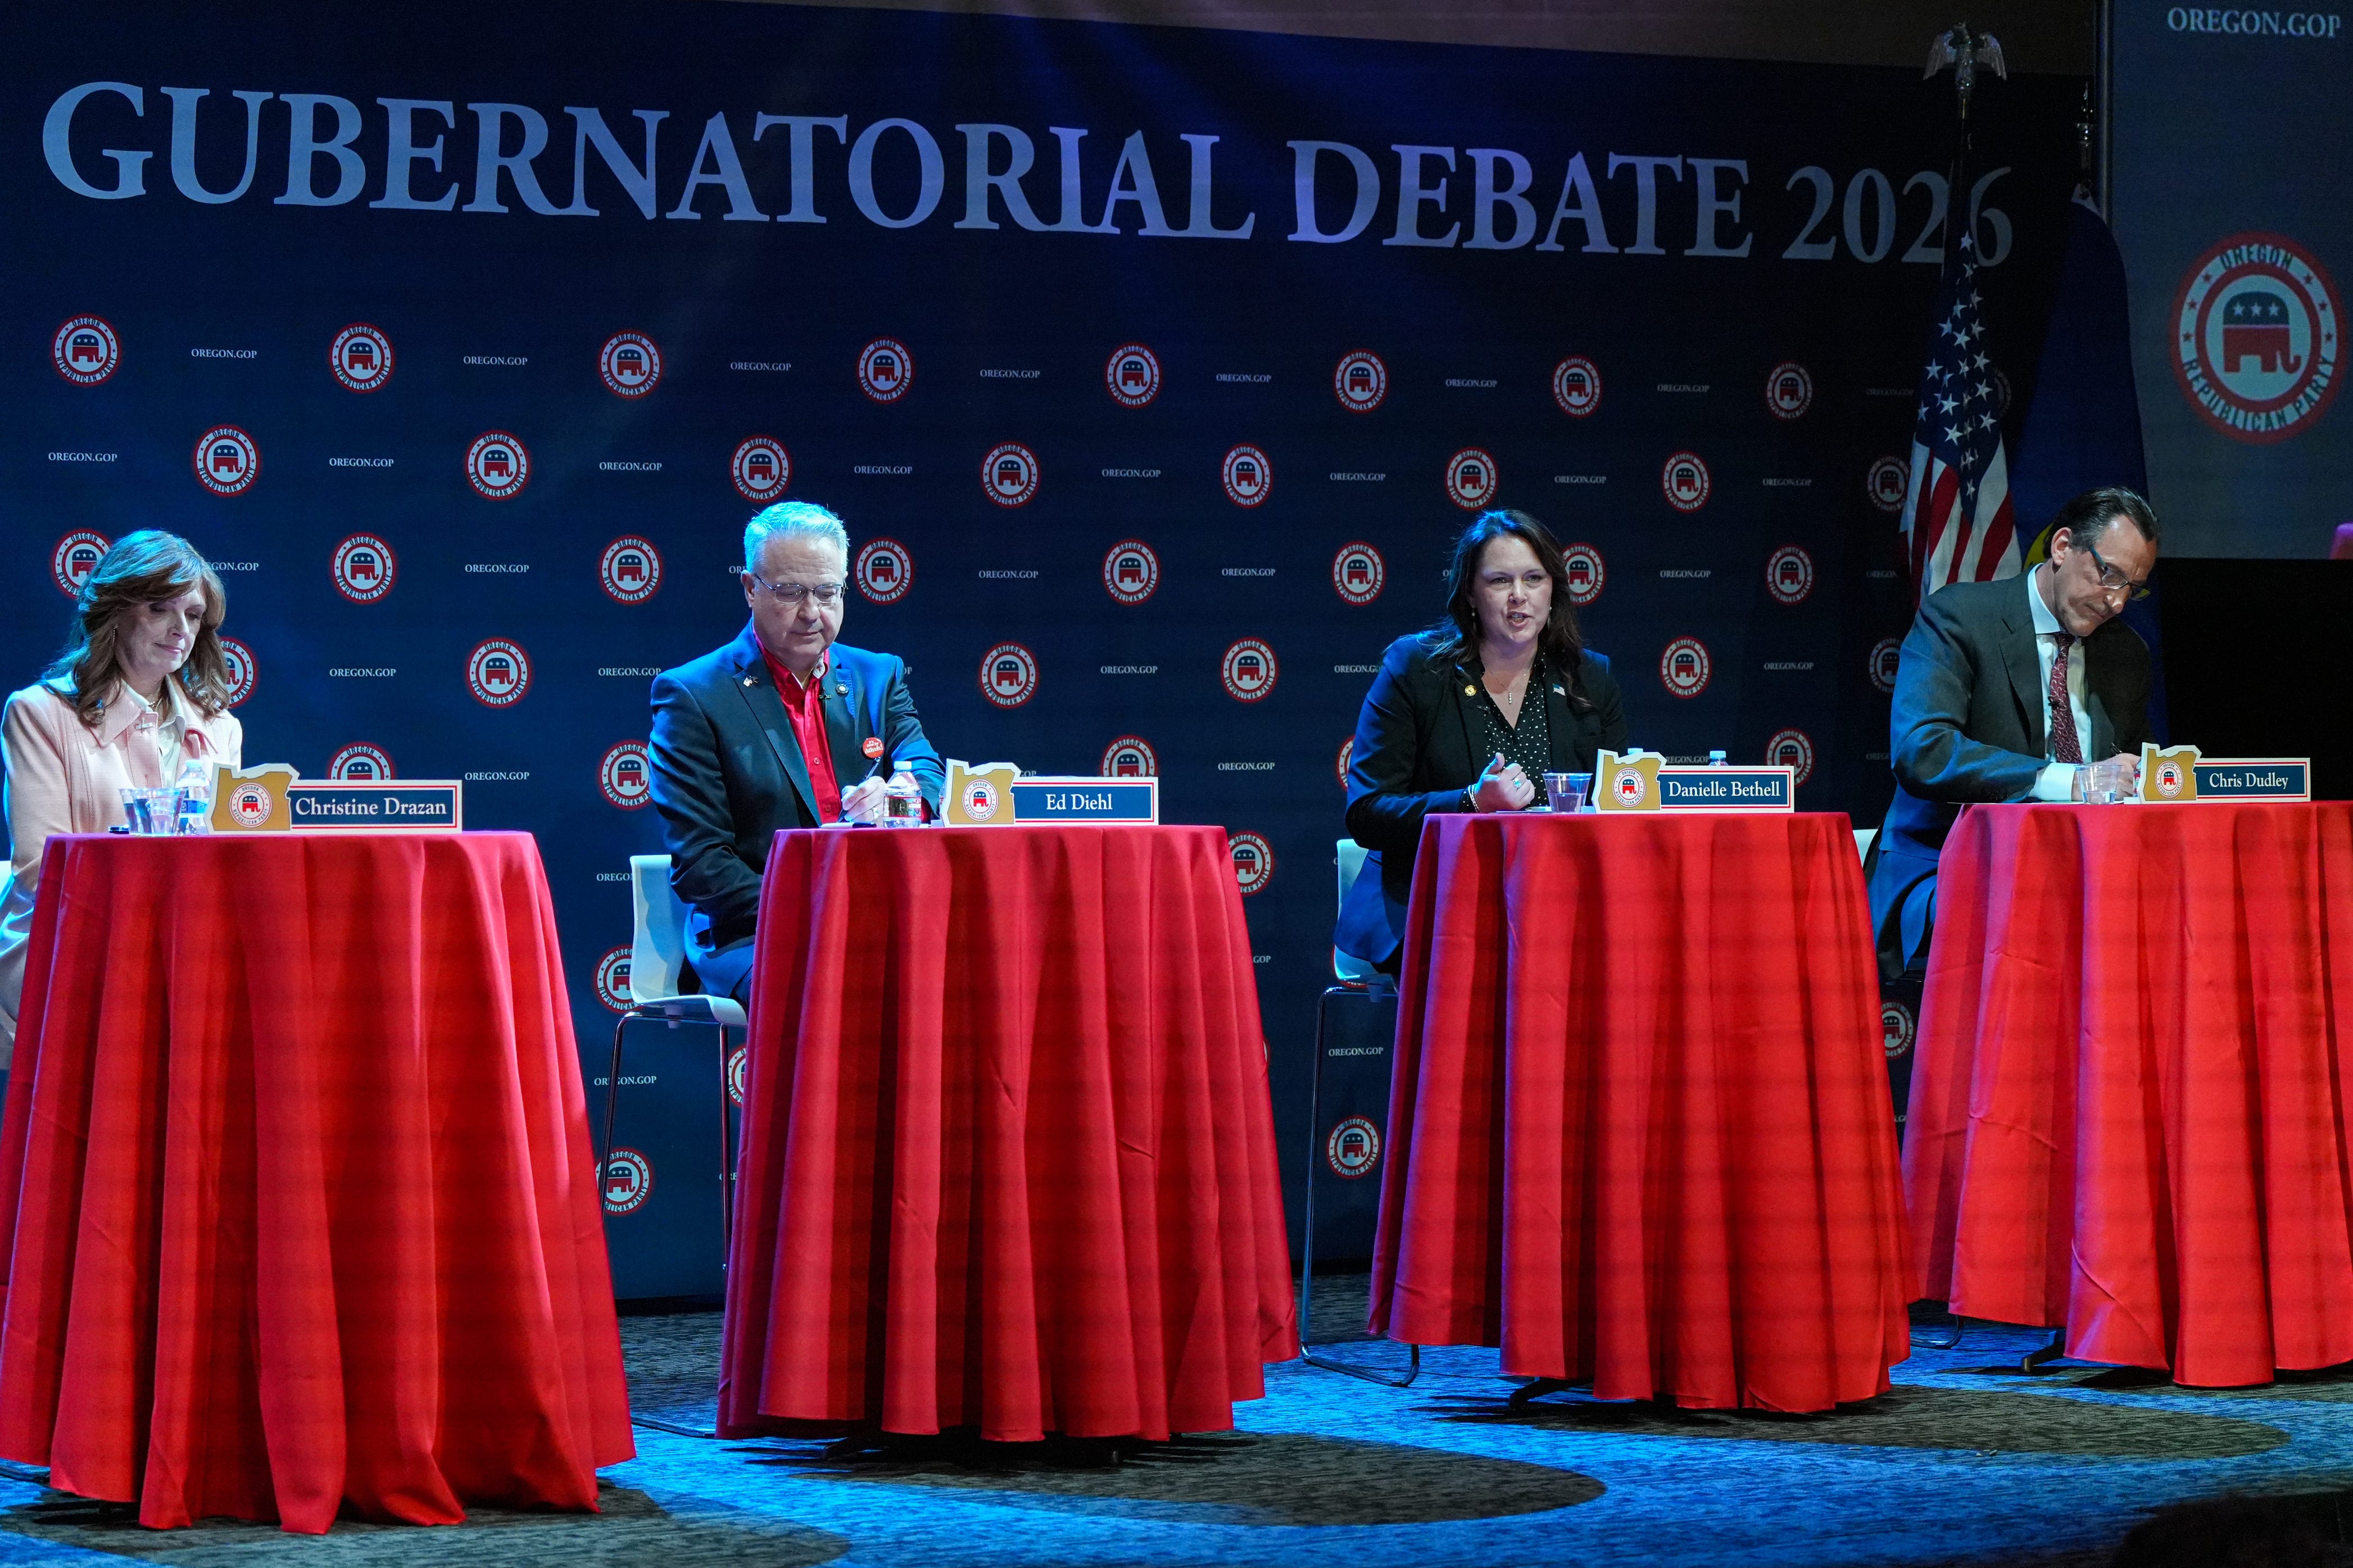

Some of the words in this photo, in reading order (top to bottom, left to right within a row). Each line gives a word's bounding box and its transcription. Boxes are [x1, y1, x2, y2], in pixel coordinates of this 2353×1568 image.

[2168, 8, 2340, 38] OREGON.GOP
[42, 81, 1255, 240] GUBERNATORIAL
[1286, 140, 1753, 258] DEBATE
[1782, 166, 2013, 267] 2026
[2220, 243, 2294, 271] OREGON
[71, 318, 100, 328] OREGON
[348, 326, 375, 336] OREGON
[616, 334, 643, 343] OREGON
[191, 348, 257, 358] OREGON.GOP
[463, 356, 528, 365] OREGON.GOP
[57, 356, 98, 383] REPUBLICAN
[99, 356, 117, 380] PARTY
[730, 362, 791, 371] OREGON.GOP
[334, 364, 373, 389] REPUBLICAN
[374, 363, 391, 387] PARTY
[980, 369, 1040, 378] OREGON.GOP
[603, 370, 642, 395] REPUBLICAN
[643, 370, 659, 392] PARTY
[1216, 374, 1272, 383] OREGON.GOP
[1445, 379, 1497, 387] OREGON.GOP
[2183, 358, 2287, 432] REPUBLICAN
[2292, 357, 2338, 417] PARTY
[212, 429, 240, 438] OREGON
[484, 434, 511, 444] OREGON
[748, 439, 774, 448] OREGON
[48, 452, 117, 462] OREGON.GOP
[329, 458, 394, 467] OREGON.GOP
[599, 462, 662, 471] OREGON.GOP
[854, 466, 913, 474] OREGON.GOP
[1101, 469, 1161, 478] OREGON.GOP
[198, 467, 238, 493] REPUBLICAN
[239, 466, 256, 490] PARTY
[1330, 472, 1386, 481] OREGON.GOP
[1554, 475, 1607, 484] OREGON.GOP
[470, 471, 509, 497] REPUBLICAN
[510, 471, 527, 494] PARTY
[735, 475, 772, 499] REPUBLICAN
[773, 475, 788, 497] PARTY
[71, 533, 98, 542] OREGON
[350, 537, 377, 546] OREGON
[617, 539, 643, 548] OREGON
[871, 541, 896, 550] OREGON
[465, 564, 529, 573] OREGON.GOP
[1221, 568, 1276, 576] OREGON.GOP
[978, 570, 1039, 579] OREGON.GOP
[336, 574, 375, 599] REPUBLICAN
[376, 574, 392, 597] PARTY
[604, 575, 642, 601] REPUBLICAN
[643, 575, 659, 598] PARTY
[858, 577, 895, 601] REPUBLICAN
[895, 576, 910, 598] PARTY
[485, 642, 511, 651] OREGON
[329, 669, 396, 677] OREGON.GOP
[598, 667, 661, 676] OREGON.GOP
[1100, 666, 1158, 674] OREGON.GOP
[237, 679, 253, 702] PARTY
[471, 679, 510, 704] REPUBLICAN
[511, 678, 527, 701] PARTY
[347, 747, 374, 756] OREGON
[617, 744, 643, 753] OREGON
[1666, 755, 1710, 764] REGON.GOP
[1217, 762, 1275, 771] OREGON.GOP
[464, 771, 529, 780] OREGON.GOP
[2209, 772, 2242, 788] Chris
[2245, 772, 2289, 790] Dudley
[604, 781, 642, 806] REPUBLICAN
[1668, 781, 1727, 797] Danielle
[1730, 781, 1780, 797] Bethell
[296, 797, 378, 815] Christine
[383, 797, 447, 815] Drazan
[1046, 793, 1066, 810] Ed
[1071, 793, 1113, 810] Diehl
[613, 949, 632, 958] OREG
[599, 987, 636, 1010] REPUBLICAN
[1328, 1047, 1384, 1056] OREGON.GOP
[632, 1186, 649, 1208] PARTY
